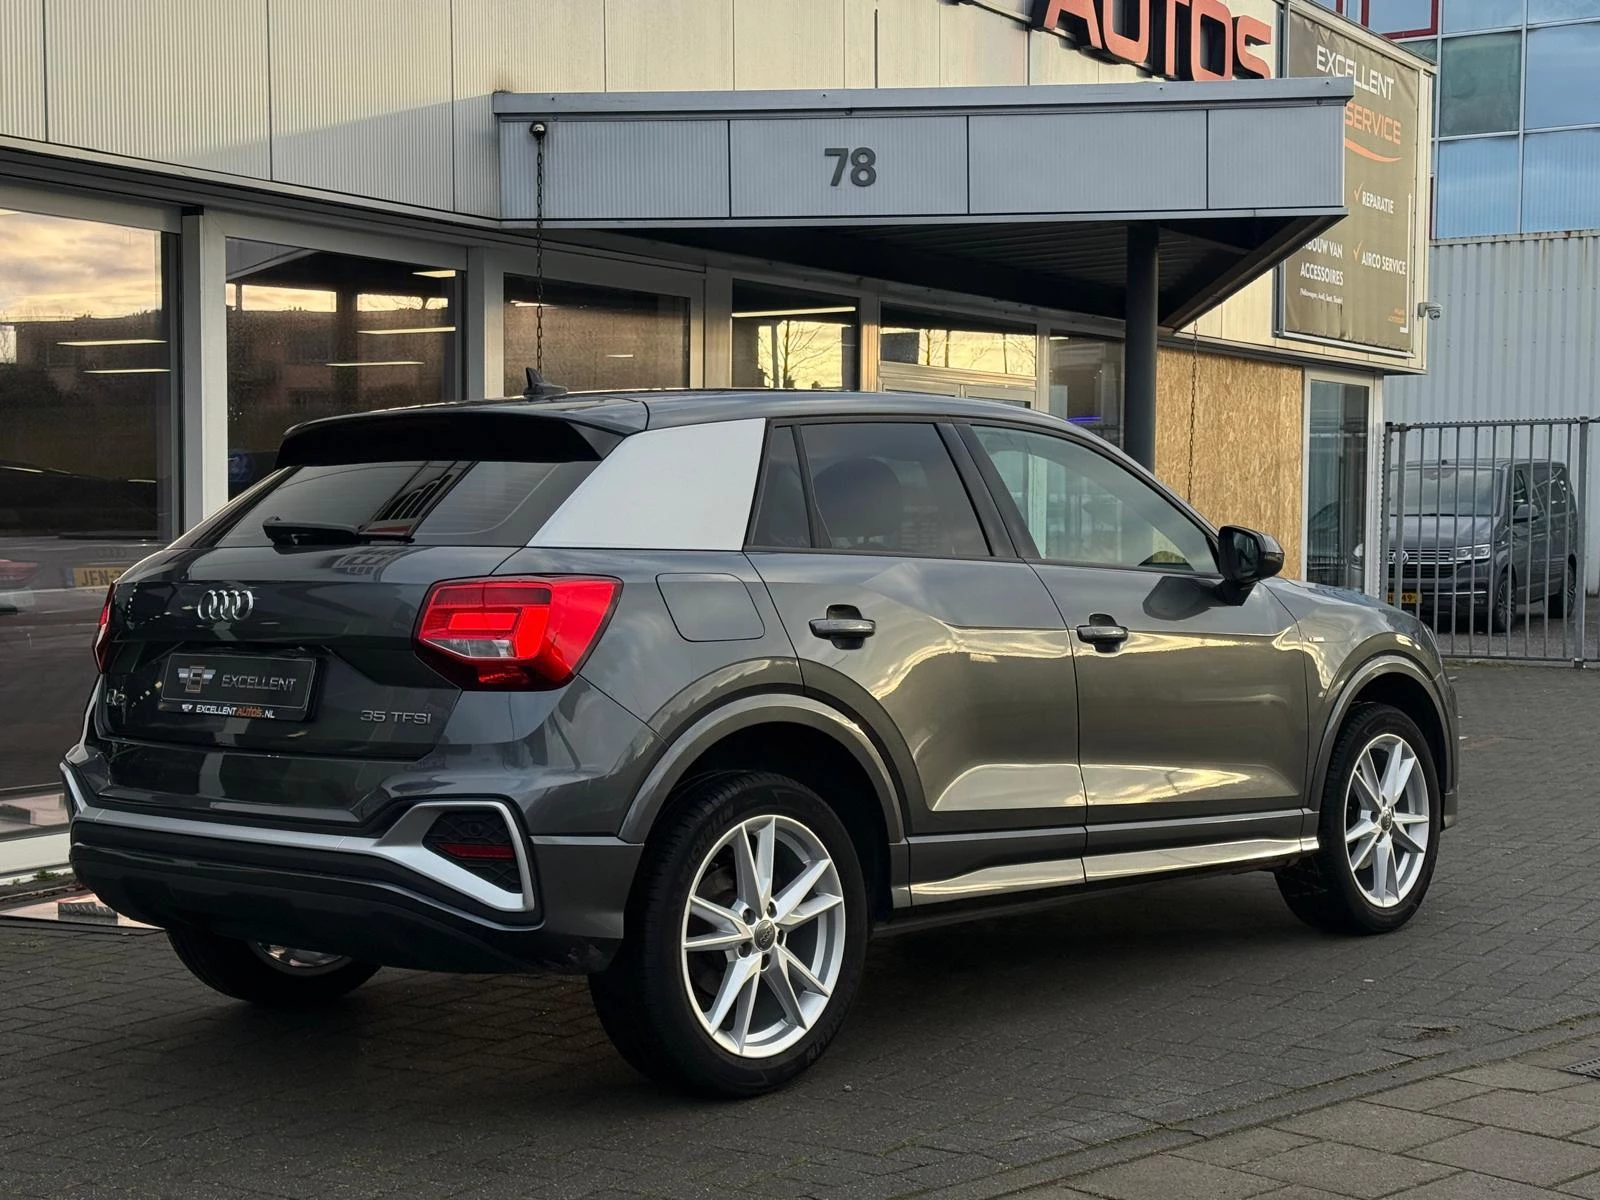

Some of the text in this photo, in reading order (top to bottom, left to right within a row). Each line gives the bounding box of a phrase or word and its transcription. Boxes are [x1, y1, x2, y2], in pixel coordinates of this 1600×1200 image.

[1316, 44, 1395, 101] EXCELLENT
[1344, 101, 1401, 145] SERVICE
[824, 146, 877, 187] 78
[1361, 190, 1394, 214] REPARATIE
[1328, 240, 1343, 259] VAN
[1299, 262, 1344, 286] ACCESSOIRES
[1361, 251, 1406, 275] AIRCO SERVICE
[221, 673, 297, 692] EXCELLENT
[360, 709, 432, 725] 35 TFSI
